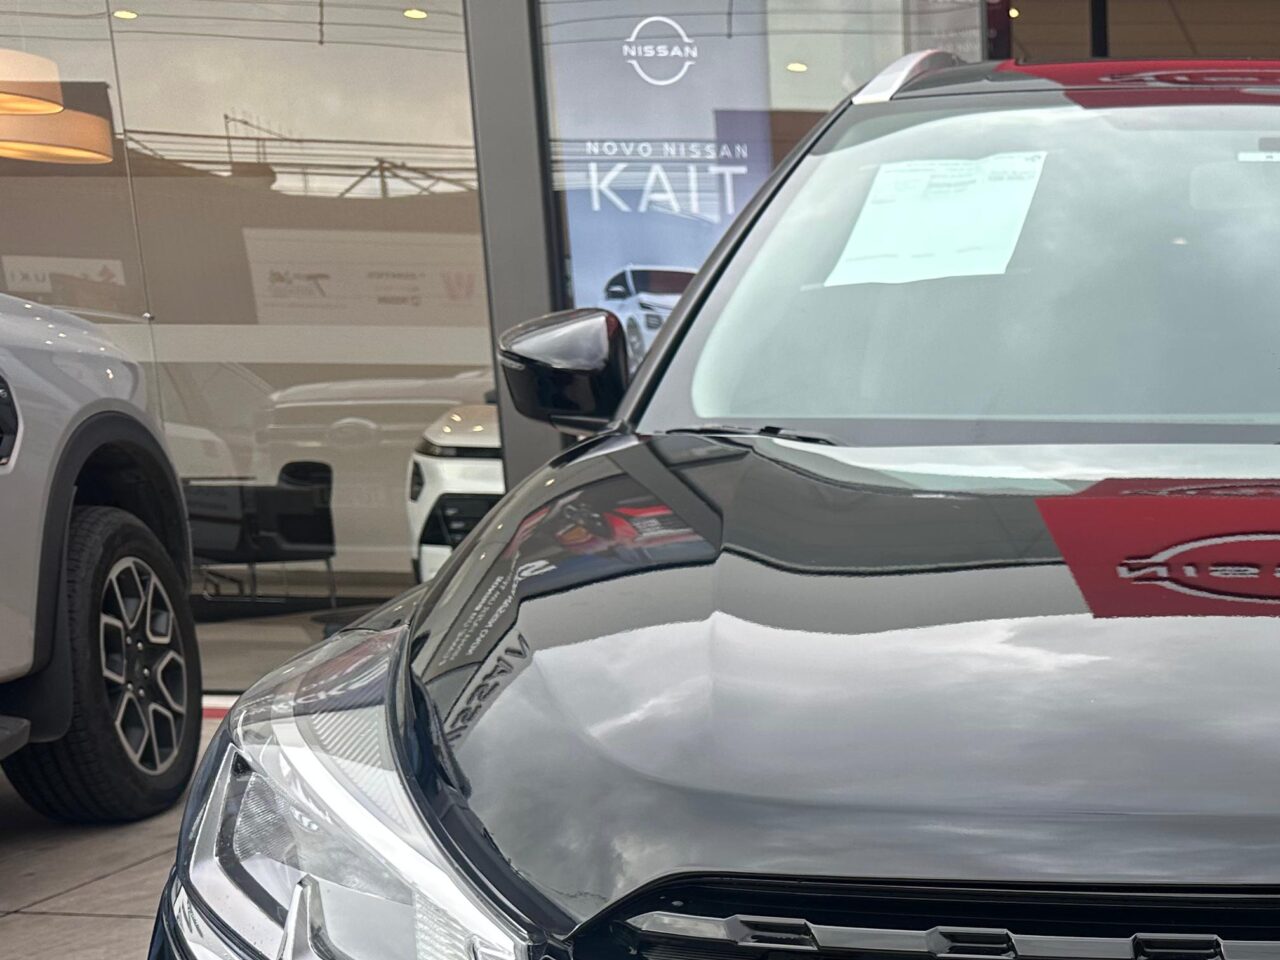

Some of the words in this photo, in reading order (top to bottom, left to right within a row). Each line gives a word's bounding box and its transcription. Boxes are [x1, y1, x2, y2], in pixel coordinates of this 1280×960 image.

[622, 44, 698, 58] NISSAN
[585, 141, 652, 157] NOVO
[663, 142, 748, 159] NISSAN
[587, 162, 748, 215] KAIT
